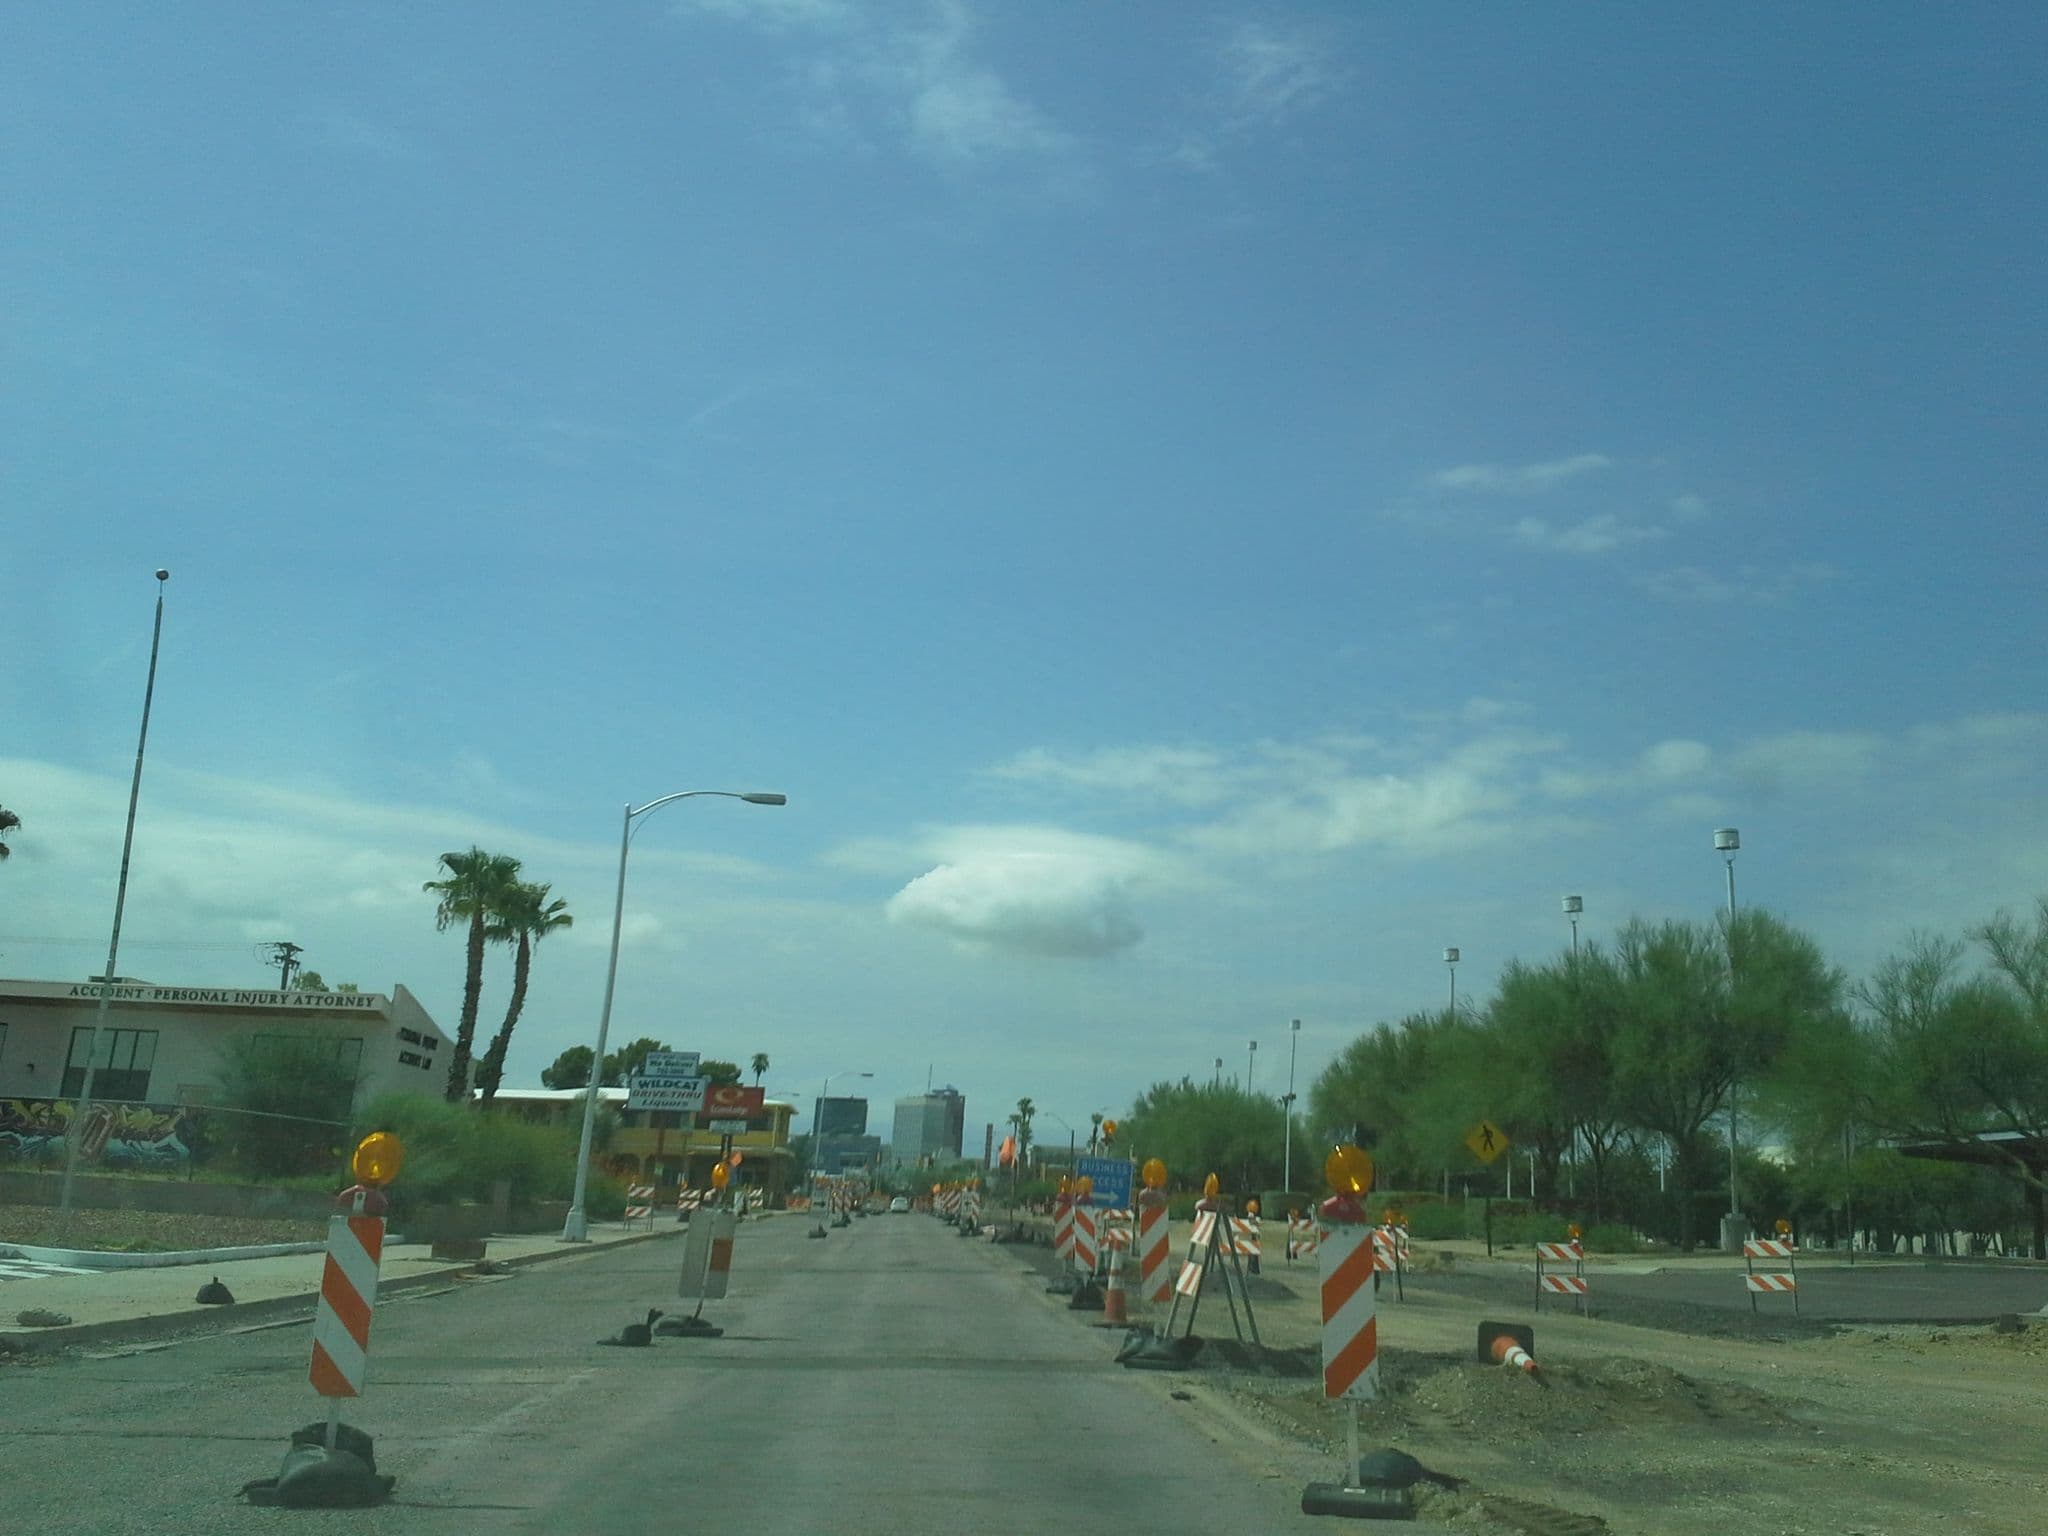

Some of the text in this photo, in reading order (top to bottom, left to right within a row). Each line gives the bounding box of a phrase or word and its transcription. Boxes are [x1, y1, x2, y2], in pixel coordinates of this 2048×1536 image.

[154, 988, 229, 1002] PERSONAL
[235, 991, 289, 1004] INJURY
[294, 994, 375, 1008] ATTORNEY
[638, 1080, 699, 1091] WILDCAT
[1081, 1160, 1128, 1174] BUSINESS
